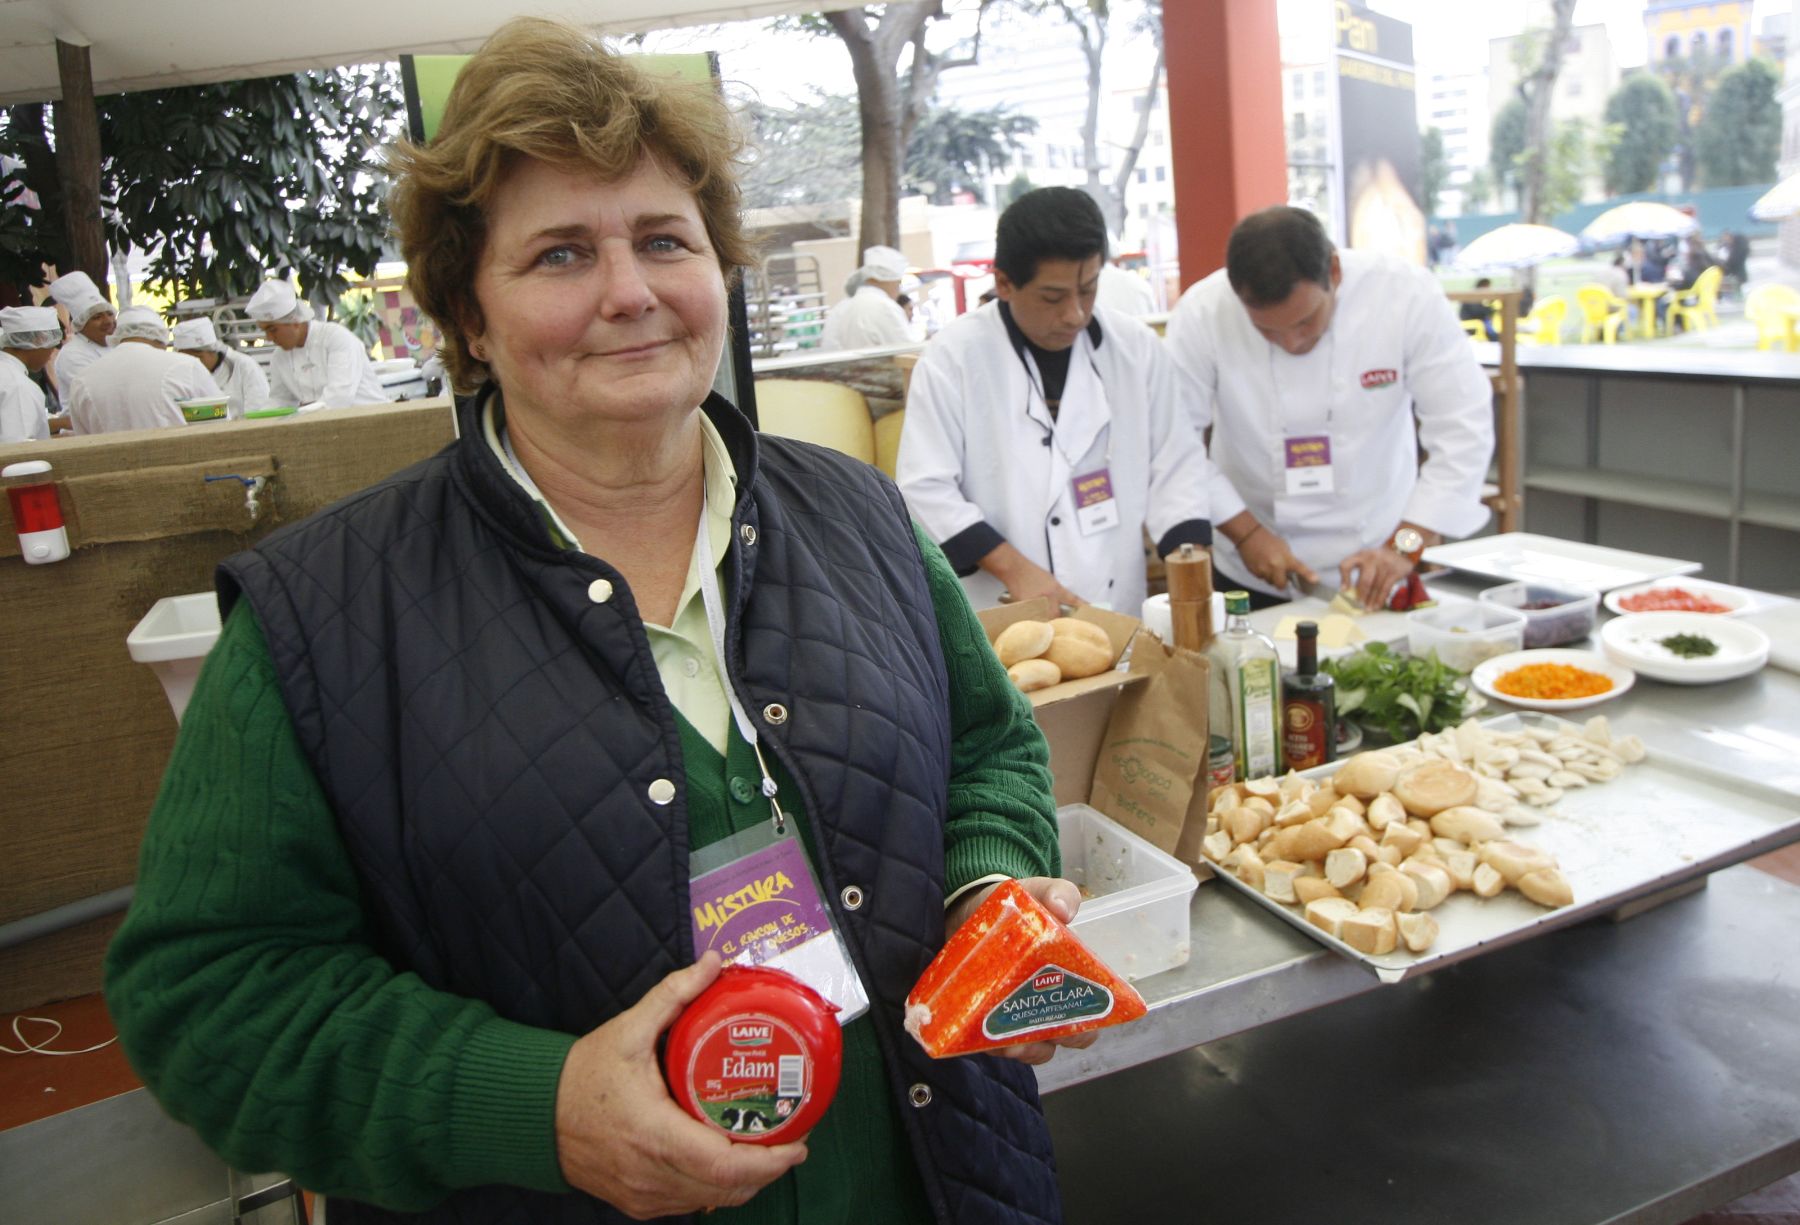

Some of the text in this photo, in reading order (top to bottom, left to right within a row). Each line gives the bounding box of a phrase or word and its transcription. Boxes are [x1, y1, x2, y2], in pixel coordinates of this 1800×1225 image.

[721, 912, 796, 955] EL RINCON DE
[766, 922, 810, 951] QUESOS
[1035, 975, 1061, 987] LAIVE
[1002, 985, 1094, 1014] SANTA CLARA
[1011, 1000, 1084, 1021] QUESO ARTESANAL
[732, 1027, 769, 1038] LAIVE
[722, 1056, 775, 1078] Edam
